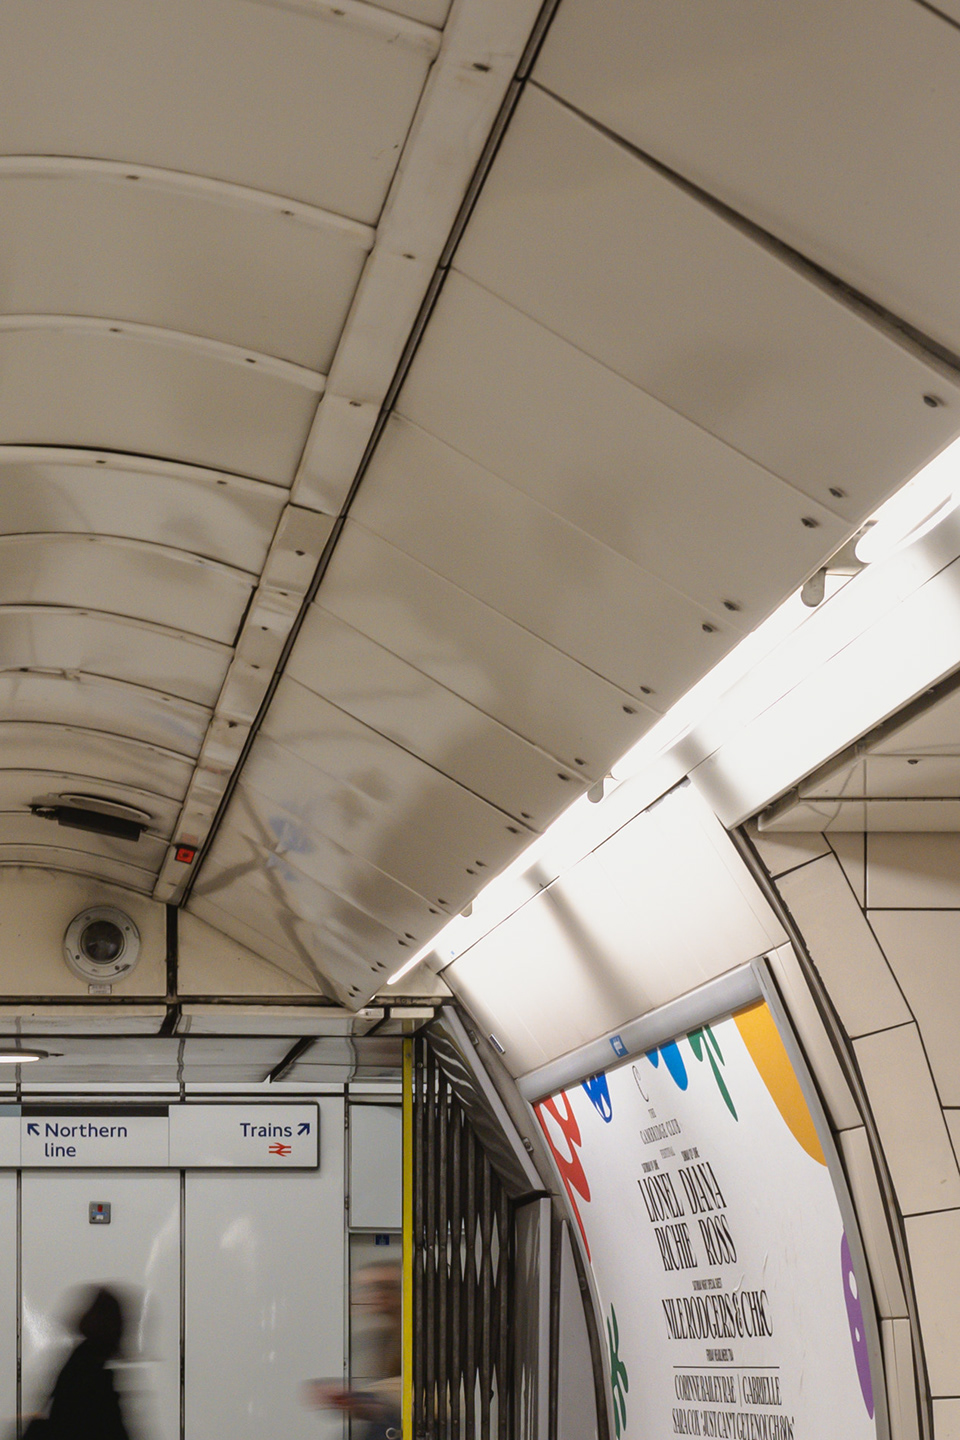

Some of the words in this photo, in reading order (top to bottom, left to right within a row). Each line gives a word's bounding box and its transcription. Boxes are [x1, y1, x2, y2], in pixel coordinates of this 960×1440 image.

[44, 1122, 128, 1139] Northern
[44, 1142, 77, 1158] line
[240, 1122, 293, 1139] Trains
[637, 1172, 685, 1222] LIONEL
[678, 1161, 728, 1215] DIANA
[654, 1222, 698, 1272] RICHIE
[698, 1214, 738, 1266] ROSS
[662, 1298, 688, 1340] NILE
[683, 1293, 736, 1340] RODGERS
[740, 1289, 774, 1338] CHIC
[742, 1376, 782, 1406] GABRIELLE
[672, 1408, 688, 1434] SARA
[736, 1412, 751, 1440] GET
